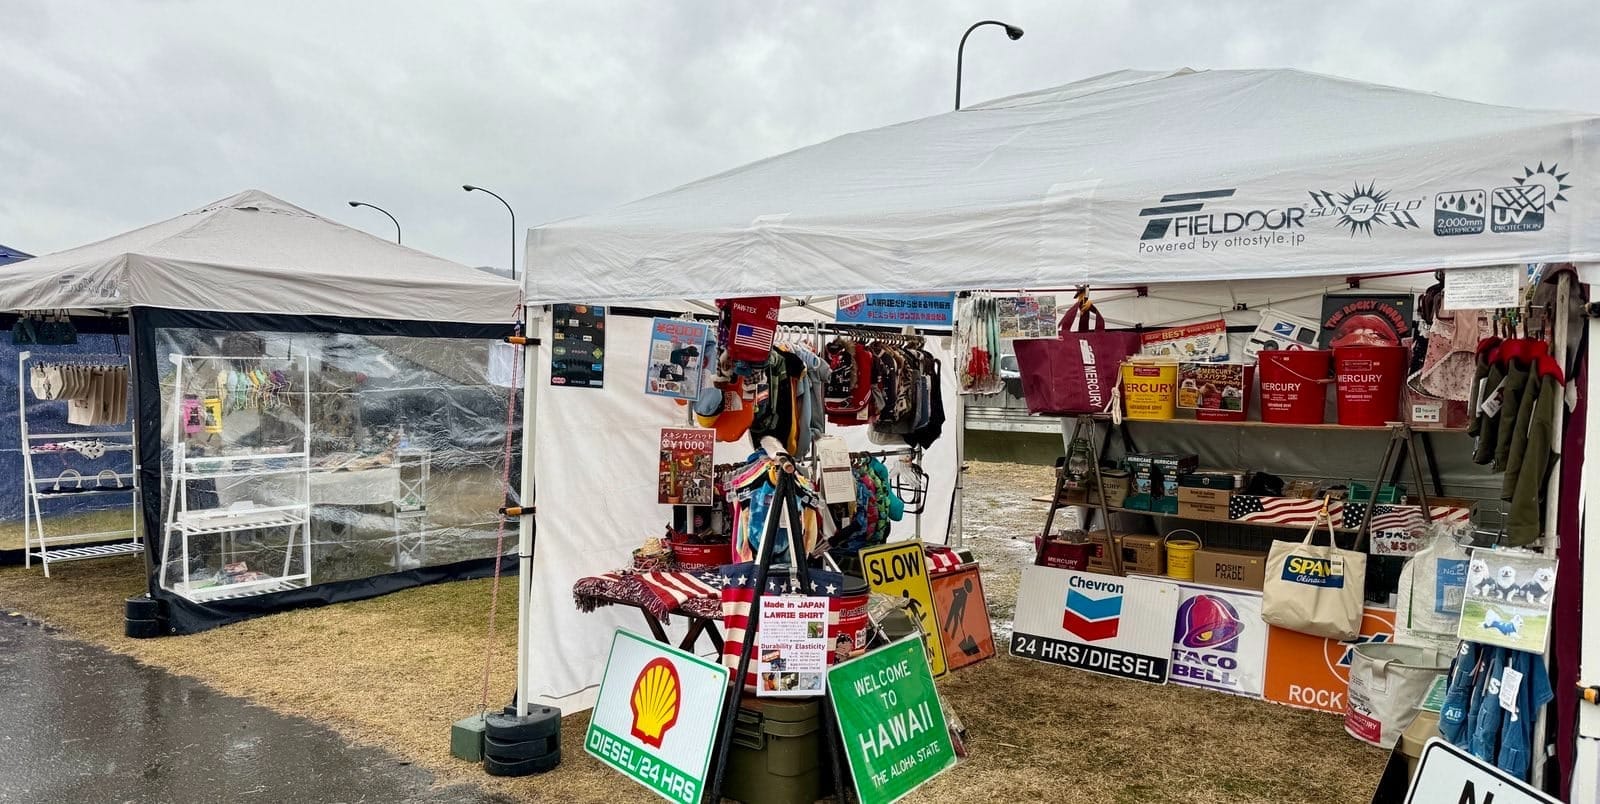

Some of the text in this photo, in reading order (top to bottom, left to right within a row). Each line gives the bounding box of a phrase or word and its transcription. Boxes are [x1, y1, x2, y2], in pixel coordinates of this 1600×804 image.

[1174, 207, 1305, 237] FIELDOOR
[1438, 217, 1483, 228] 2,000mm
[1494, 209, 1525, 224] UV
[1437, 226, 1483, 235] WATERPROOF
[1494, 223, 1542, 232] PROTECTION
[1139, 231, 1305, 253] Powered by ottostyle.jp
[1343, 300, 1377, 315] ROCKY
[1162, 328, 1186, 340] BEST
[1084, 366, 1102, 408] MERCURY
[671, 440, 705, 449] ¥1000
[870, 551, 919, 585] SLOW
[1048, 556, 1078, 566] MERCURY
[1069, 575, 1124, 593] Chevron
[763, 601, 825, 609] Made in JAPAN
[764, 611, 825, 619] LAWRIE SHIRT
[1016, 637, 1037, 654] 24
[1172, 648, 1238, 670] TACO
[854, 660, 911, 697] WELCOME
[1172, 665, 1238, 685] BELL
[1488, 676, 1501, 694] S
[880, 690, 897, 709] TO
[1289, 684, 1343, 709] ROCK
[858, 701, 934, 763] HAWAII
[871, 740, 940, 788] THE ALOHA STATE
[661, 768, 696, 803] HRS
